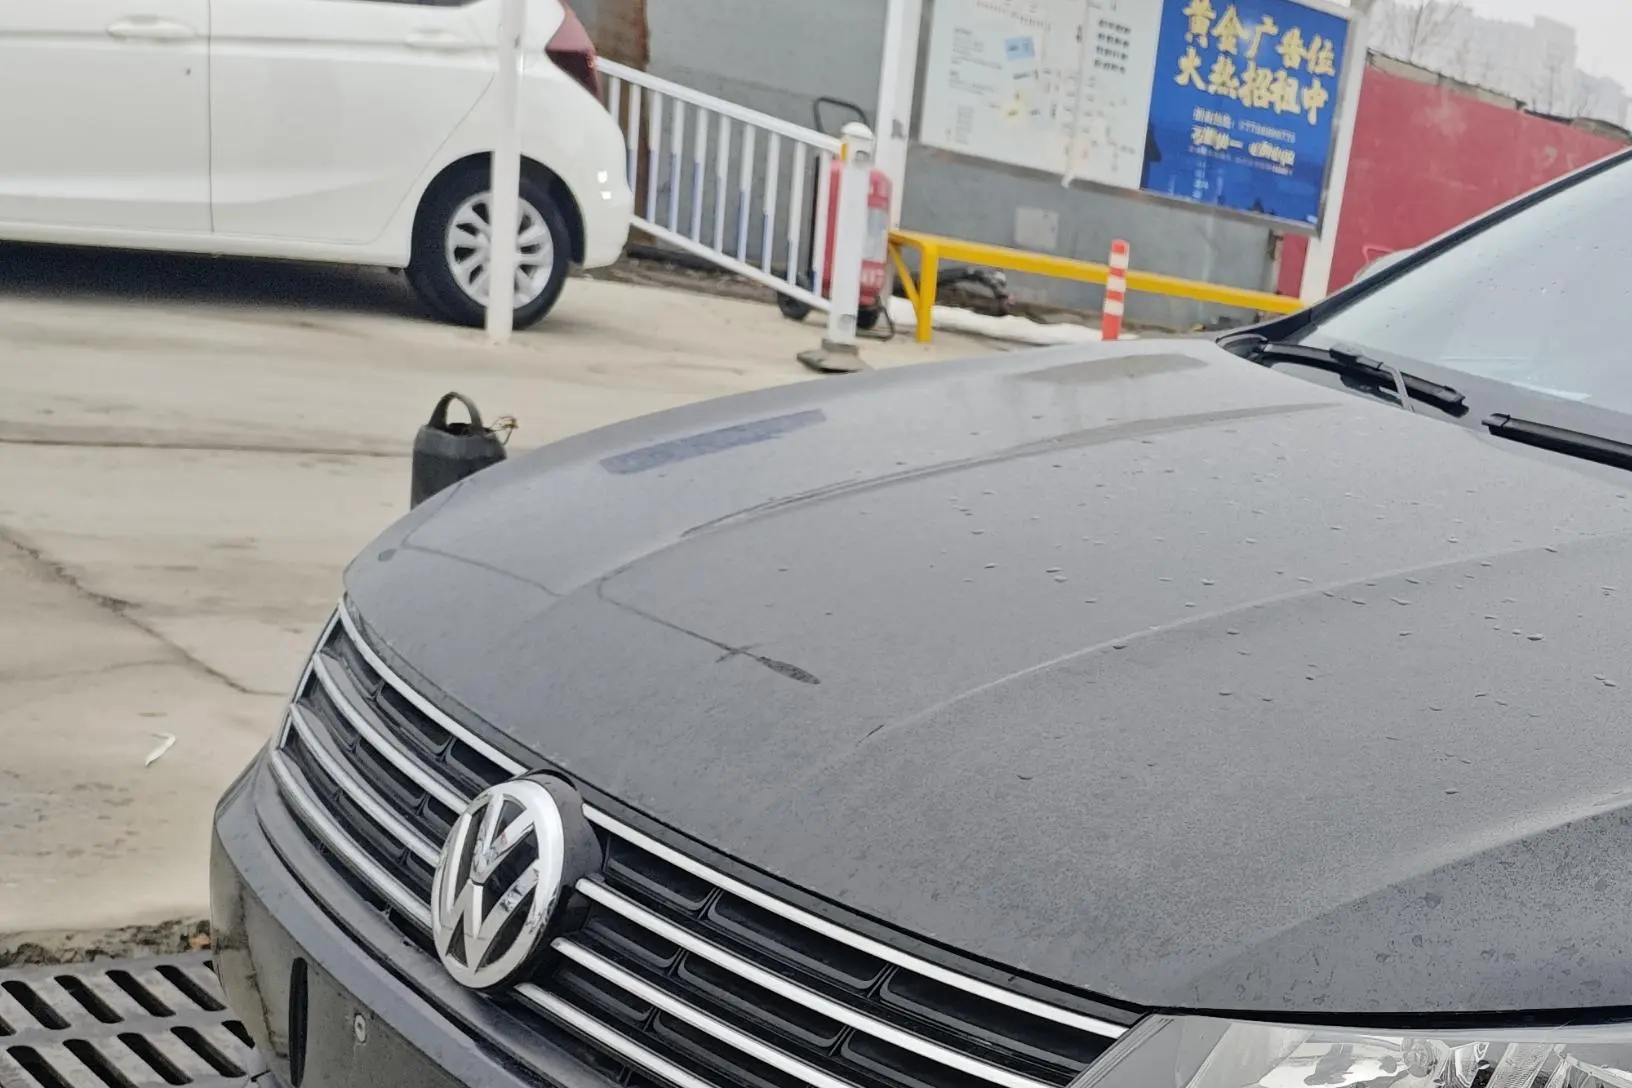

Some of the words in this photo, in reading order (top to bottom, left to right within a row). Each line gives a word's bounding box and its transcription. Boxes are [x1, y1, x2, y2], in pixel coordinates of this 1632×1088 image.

[1183, 0, 1335, 76] 黄金广告位
[1175, 47, 1329, 125] 火热招租中
[434, 788, 563, 975] VW
